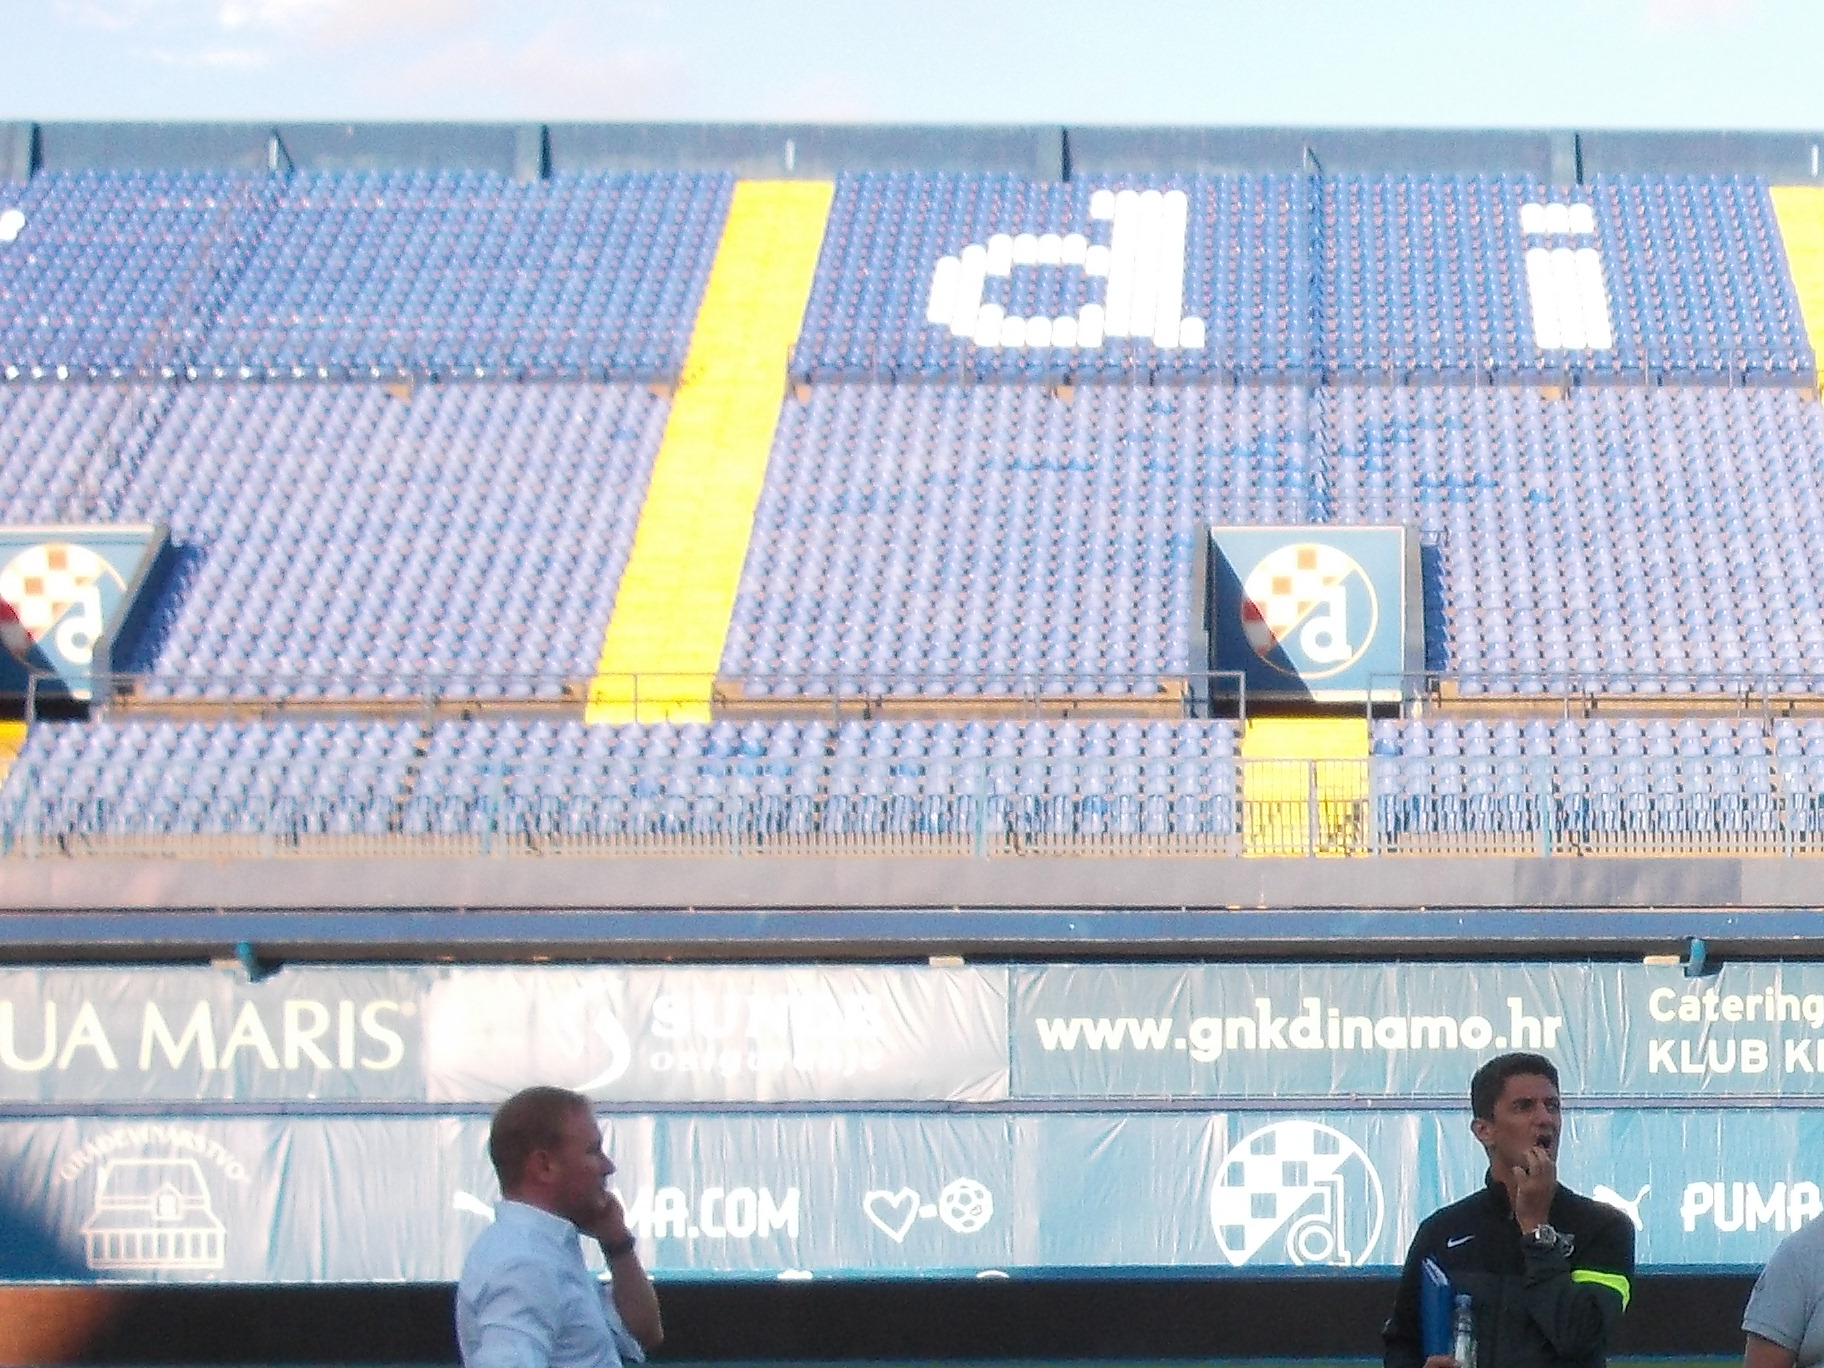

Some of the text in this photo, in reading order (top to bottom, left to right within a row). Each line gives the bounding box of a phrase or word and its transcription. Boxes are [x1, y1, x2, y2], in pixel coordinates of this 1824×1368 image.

[1035, 997, 1563, 1062] www.gnkdinamo.hr
[1649, 986, 1824, 1029] Catering
[138, 1000, 405, 1070] MARIS
[1649, 1038, 1769, 1074] KLUB
